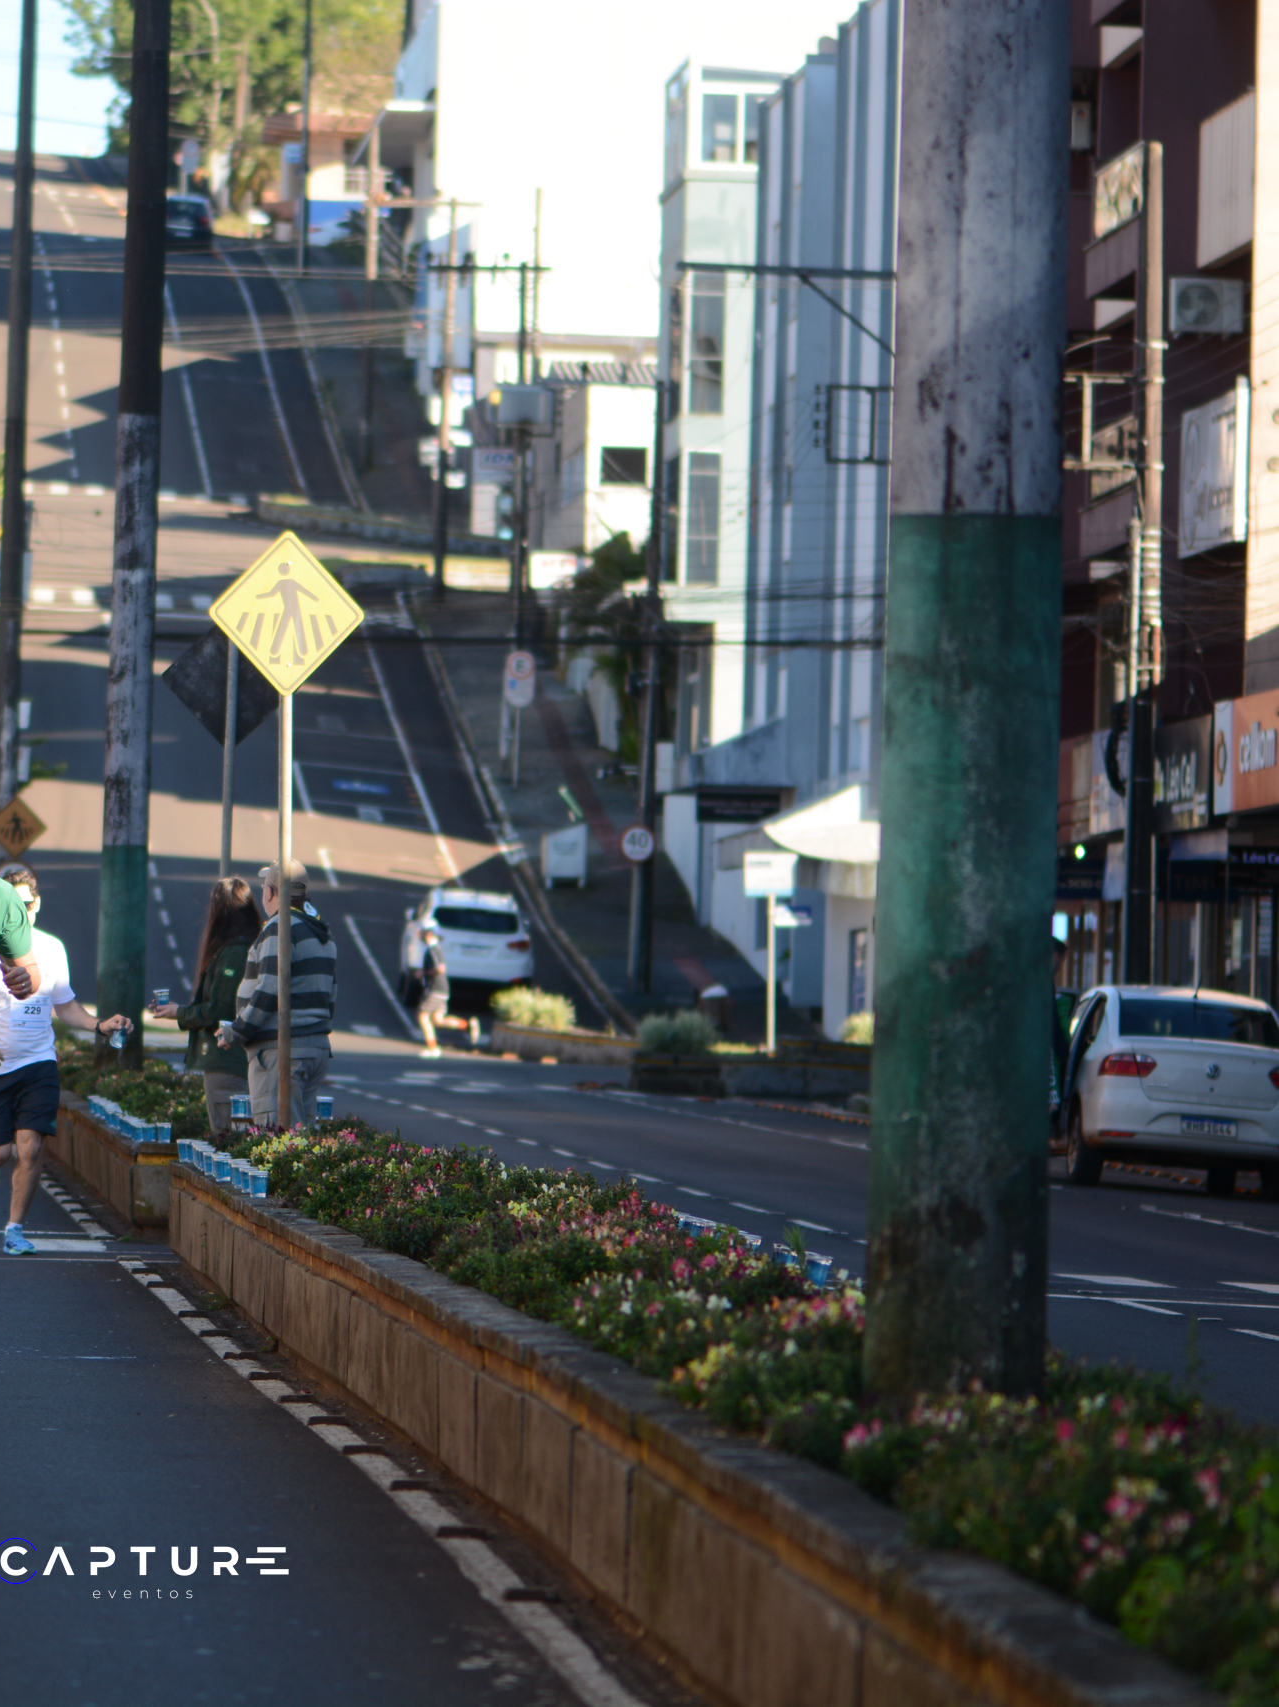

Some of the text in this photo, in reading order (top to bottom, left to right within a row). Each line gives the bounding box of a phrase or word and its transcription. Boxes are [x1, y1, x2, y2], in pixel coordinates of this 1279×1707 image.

[516, 659, 526, 674] E
[626, 832, 648, 849] 40
[1243, 852, 1265, 864] Léo
[23, 1005, 42, 1015] 229
